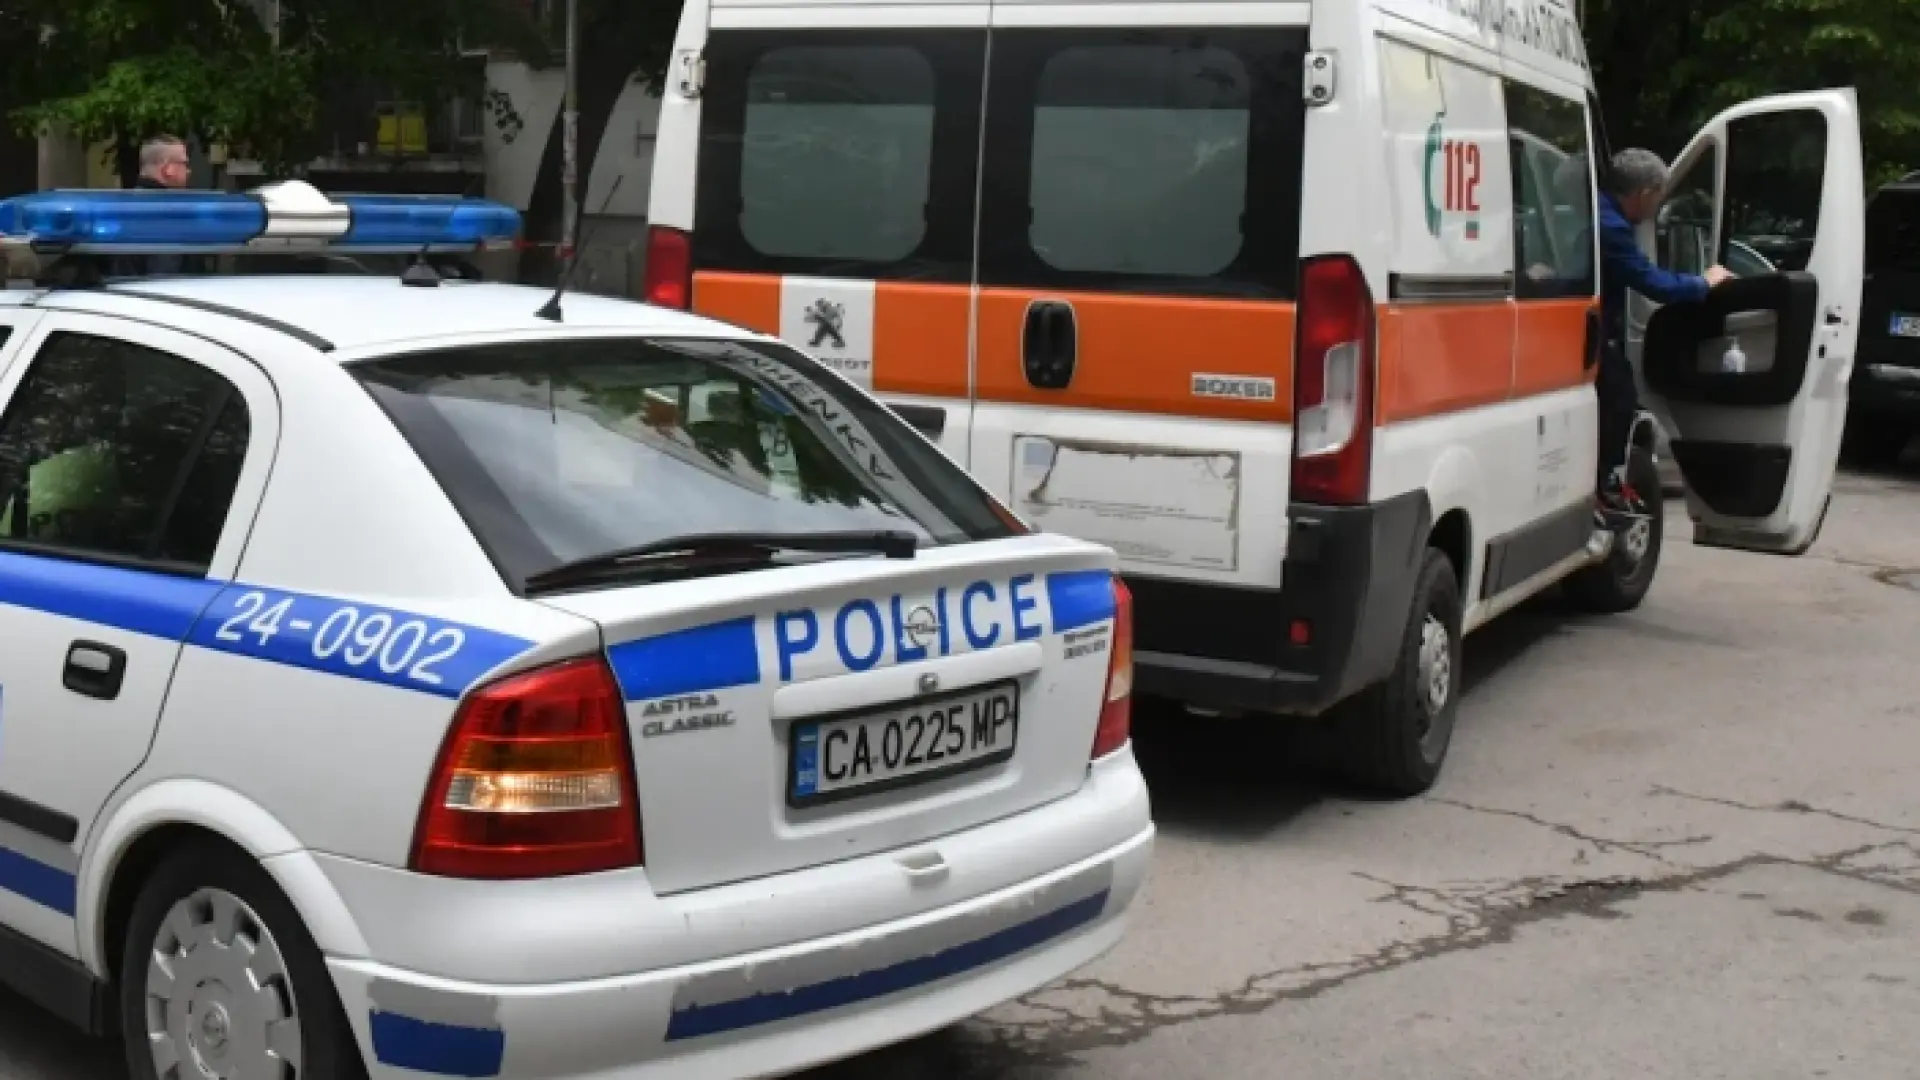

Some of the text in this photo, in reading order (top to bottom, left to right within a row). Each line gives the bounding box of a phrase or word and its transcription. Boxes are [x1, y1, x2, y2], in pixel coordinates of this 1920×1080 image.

[1443, 139, 1481, 211] 112
[1193, 376, 1274, 398] BOXER
[215, 592, 465, 684] 24-0902
[774, 573, 1042, 682] POLICE
[643, 694, 719, 716] ASTRA
[643, 710, 737, 737] CLASSIC
[824, 695, 1009, 781] CA 0225 MP
